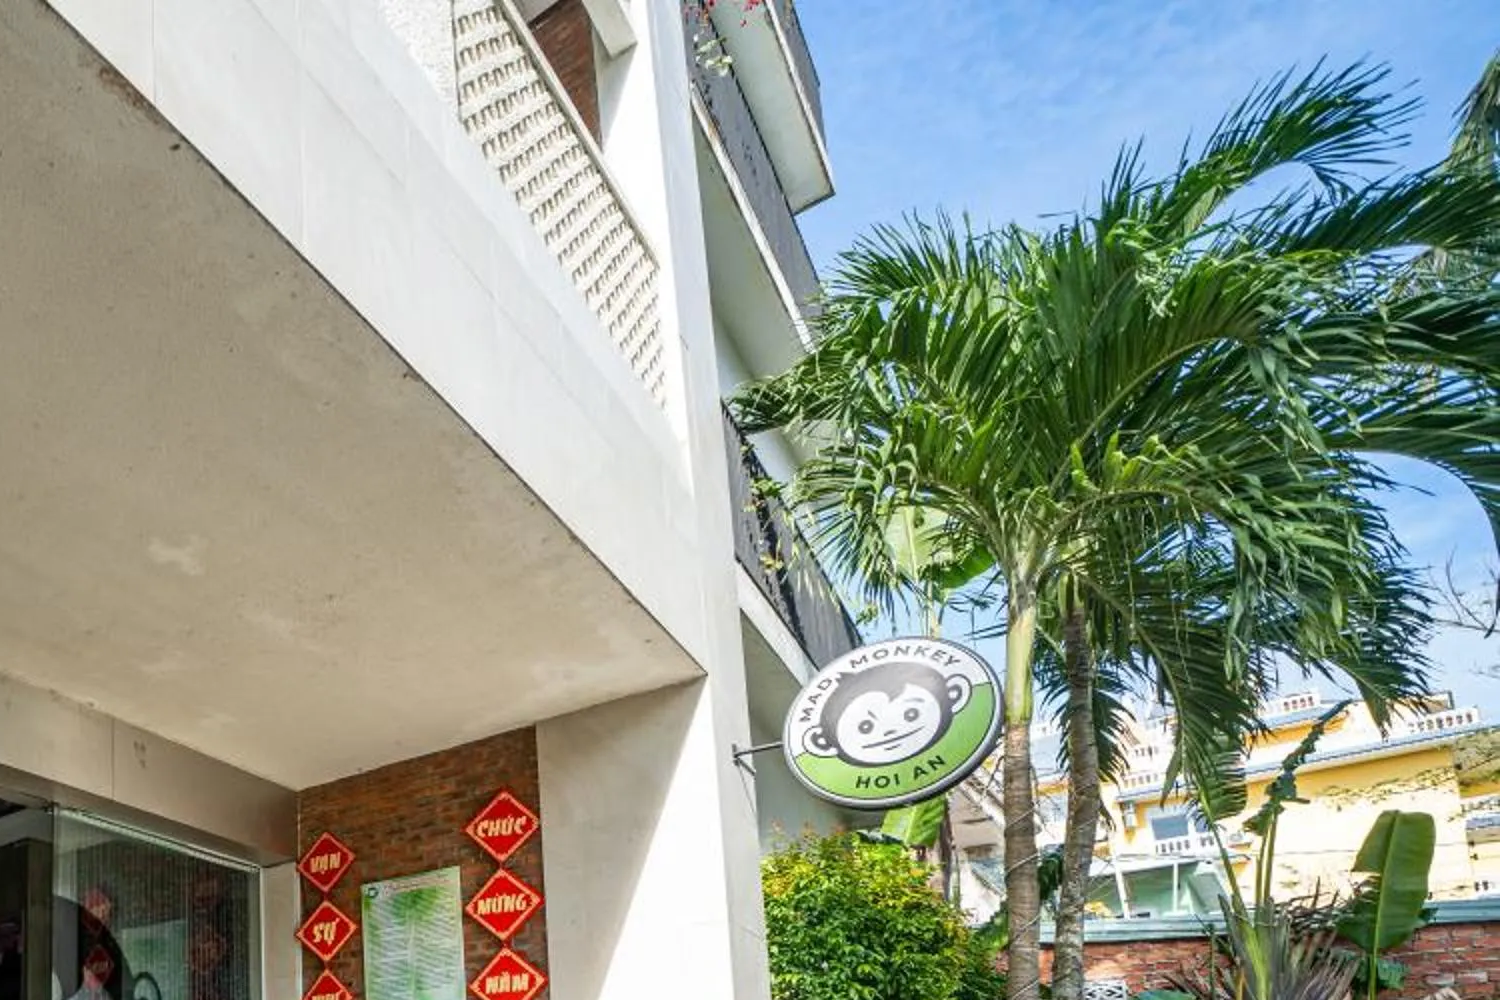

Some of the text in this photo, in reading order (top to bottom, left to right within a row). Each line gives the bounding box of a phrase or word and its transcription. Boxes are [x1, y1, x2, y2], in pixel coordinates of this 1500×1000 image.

[800, 644, 962, 722] MAD MONKEY
[855, 754, 946, 789] HOI AN
[476, 814, 527, 838] CHÚC
[477, 891, 527, 915] MỪNG
[485, 971, 529, 994] NĂM
